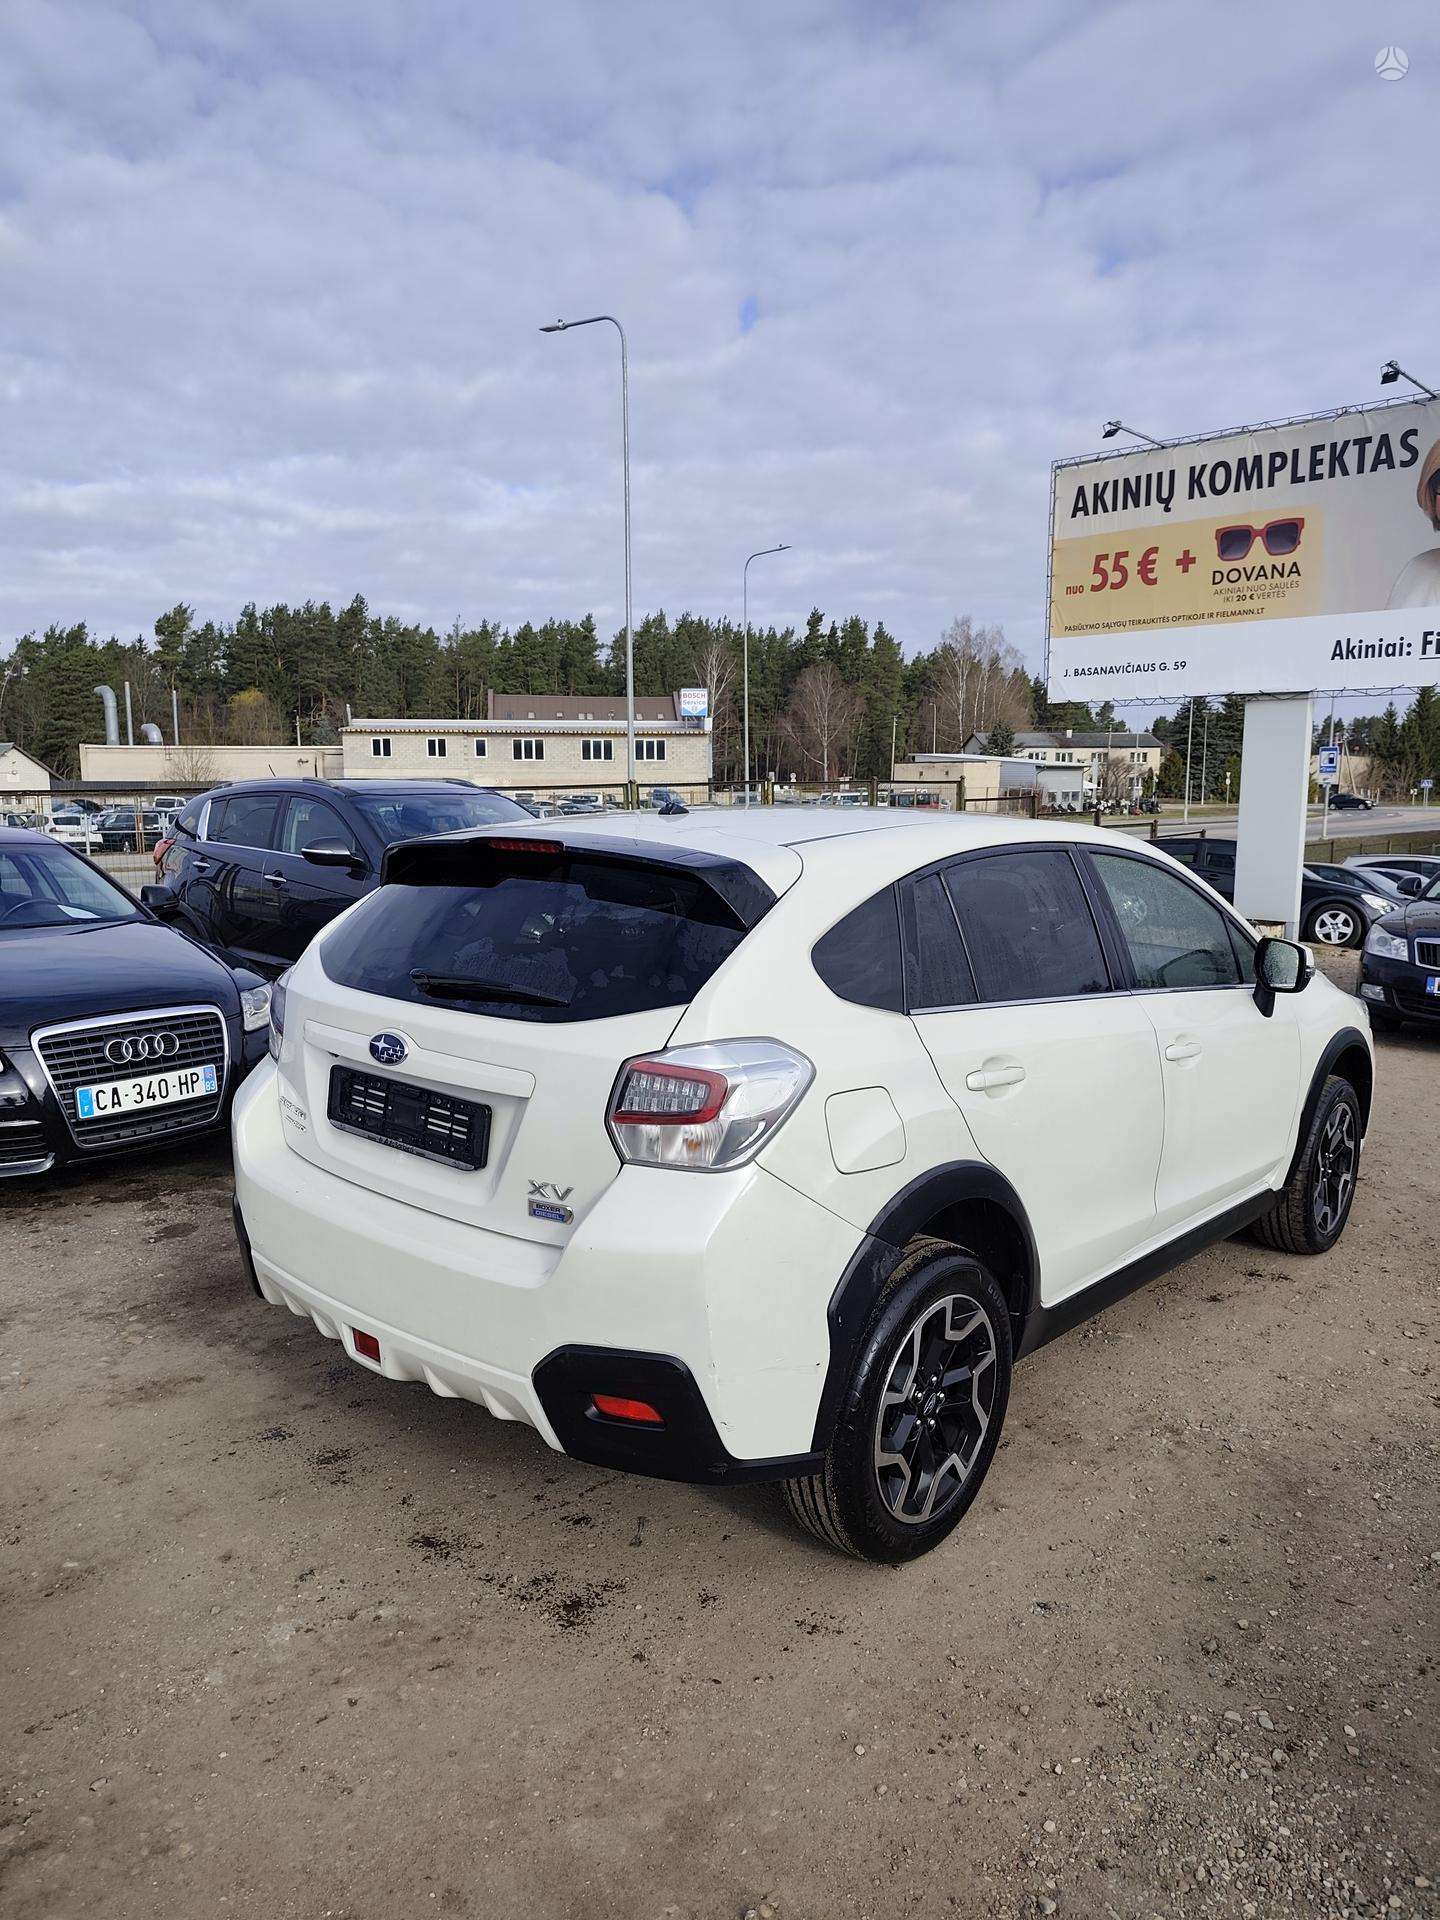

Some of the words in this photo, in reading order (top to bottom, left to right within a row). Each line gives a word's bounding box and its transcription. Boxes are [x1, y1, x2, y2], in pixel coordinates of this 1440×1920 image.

[1071, 469, 1176, 518] AKINIŲ
[1188, 428, 1419, 500] KOMPLEKTAS
[1212, 561, 1301, 585] DOVANA
[1065, 584, 1084, 596] nuo
[1212, 586, 1245, 596] AKINIAI
[1246, 583, 1267, 593] NUO
[1235, 594, 1247, 602] 20
[1064, 622, 1101, 633] PASIŪLYMO
[1171, 612, 1206, 622] OPTIKOJE
[1215, 607, 1265, 618] FIELMANN.LT
[1330, 636, 1413, 661] Akiniai:
[1063, 668, 1071, 678] J.
[1073, 662, 1157, 677] BASANAVIČIAUS
[1158, 662, 1170, 672] G.
[1173, 660, 1187, 671] 59
[528, 1179, 575, 1202] XV
[534, 1210, 563, 1221] DIESEL
